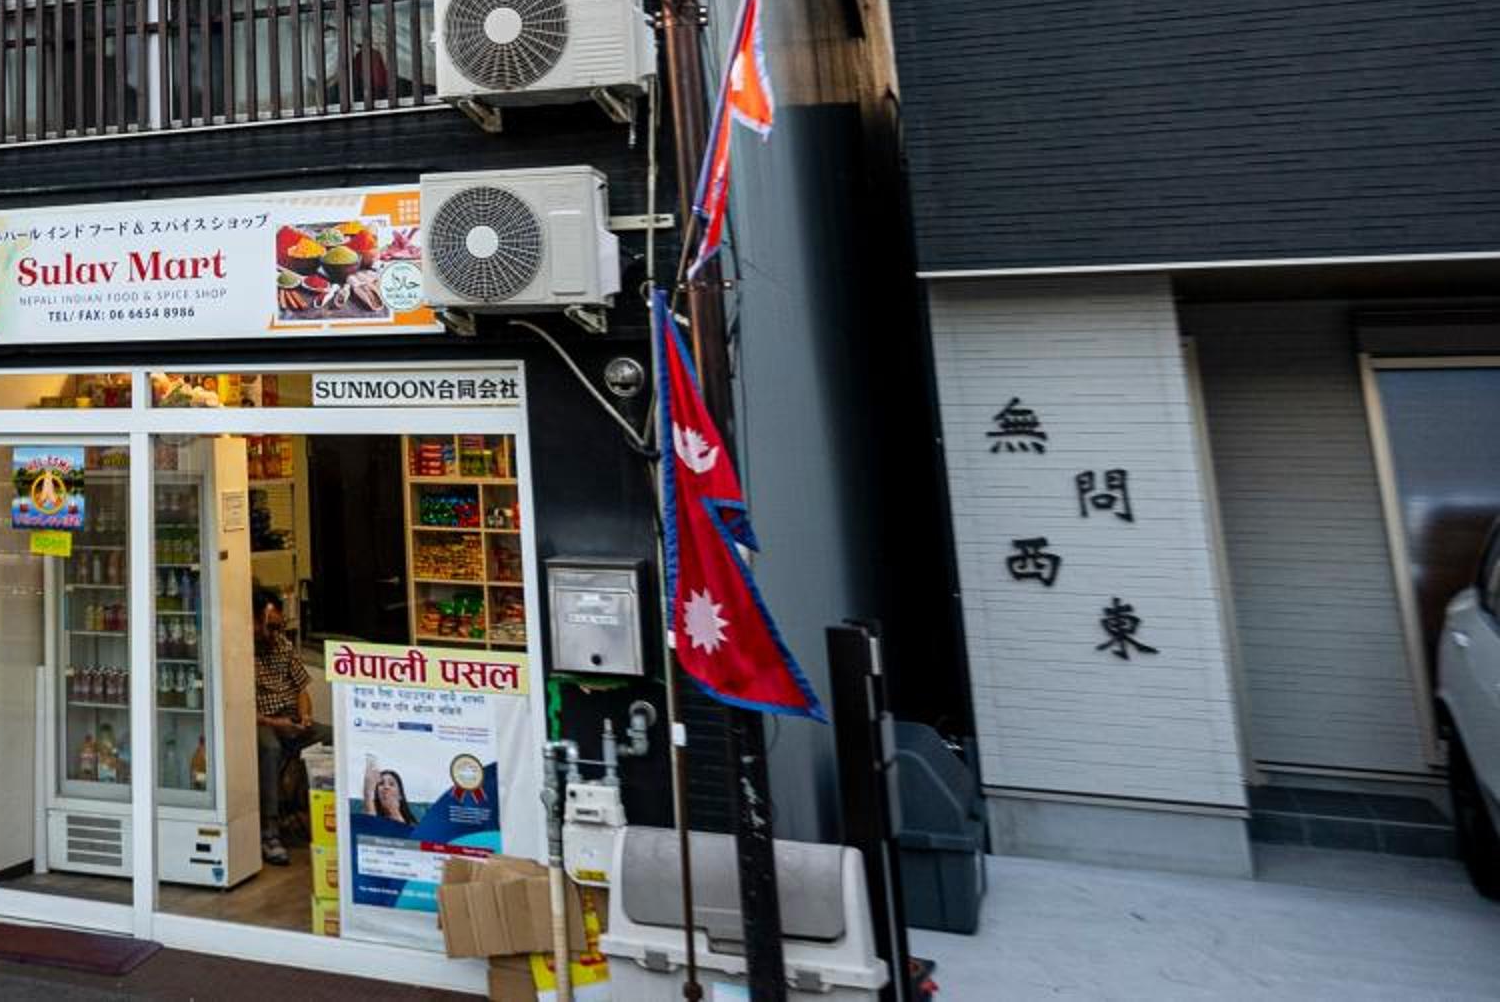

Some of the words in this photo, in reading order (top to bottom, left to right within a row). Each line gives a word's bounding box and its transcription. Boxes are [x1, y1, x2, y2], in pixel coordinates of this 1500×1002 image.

[17, 251, 118, 287] Sulav
[128, 249, 228, 282] Mart
[19, 295, 57, 307] NEPALI
[61, 293, 102, 304] INDIAN
[107, 291, 139, 303] FOOD
[157, 289, 189, 300] SPICE
[195, 287, 228, 299] SHOP
[78, 309, 105, 320] FAX:
[109, 309, 125, 320] 06
[128, 308, 159, 319] 6654
[163, 307, 195, 318] 8986
[314, 379, 519, 400] SUNMOON合同会社
[332, 645, 429, 684] नेपाली
[438, 659, 521, 690] पसल
